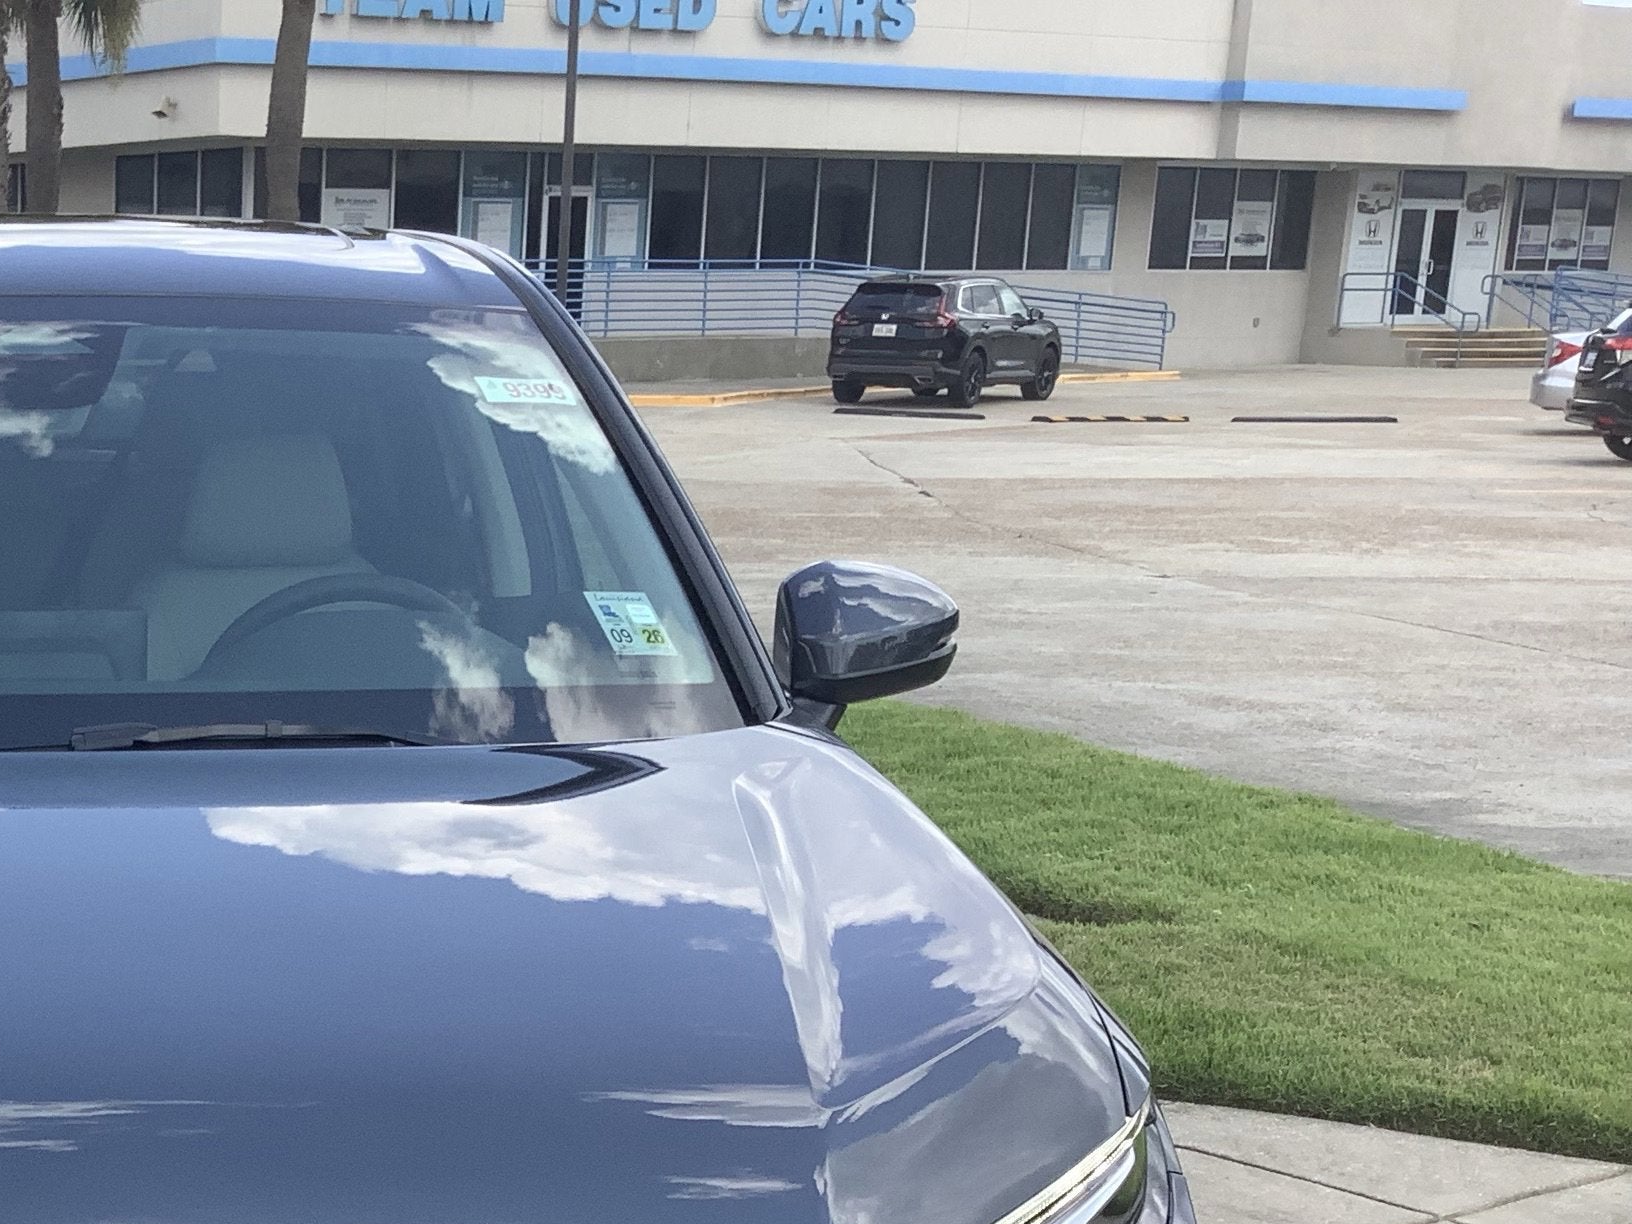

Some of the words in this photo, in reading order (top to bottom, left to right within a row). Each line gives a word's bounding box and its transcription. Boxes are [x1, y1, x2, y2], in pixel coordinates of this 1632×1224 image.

[761, 0, 916, 42] CARS
[610, 628, 633, 643] 09
[642, 629, 665, 644] 26
